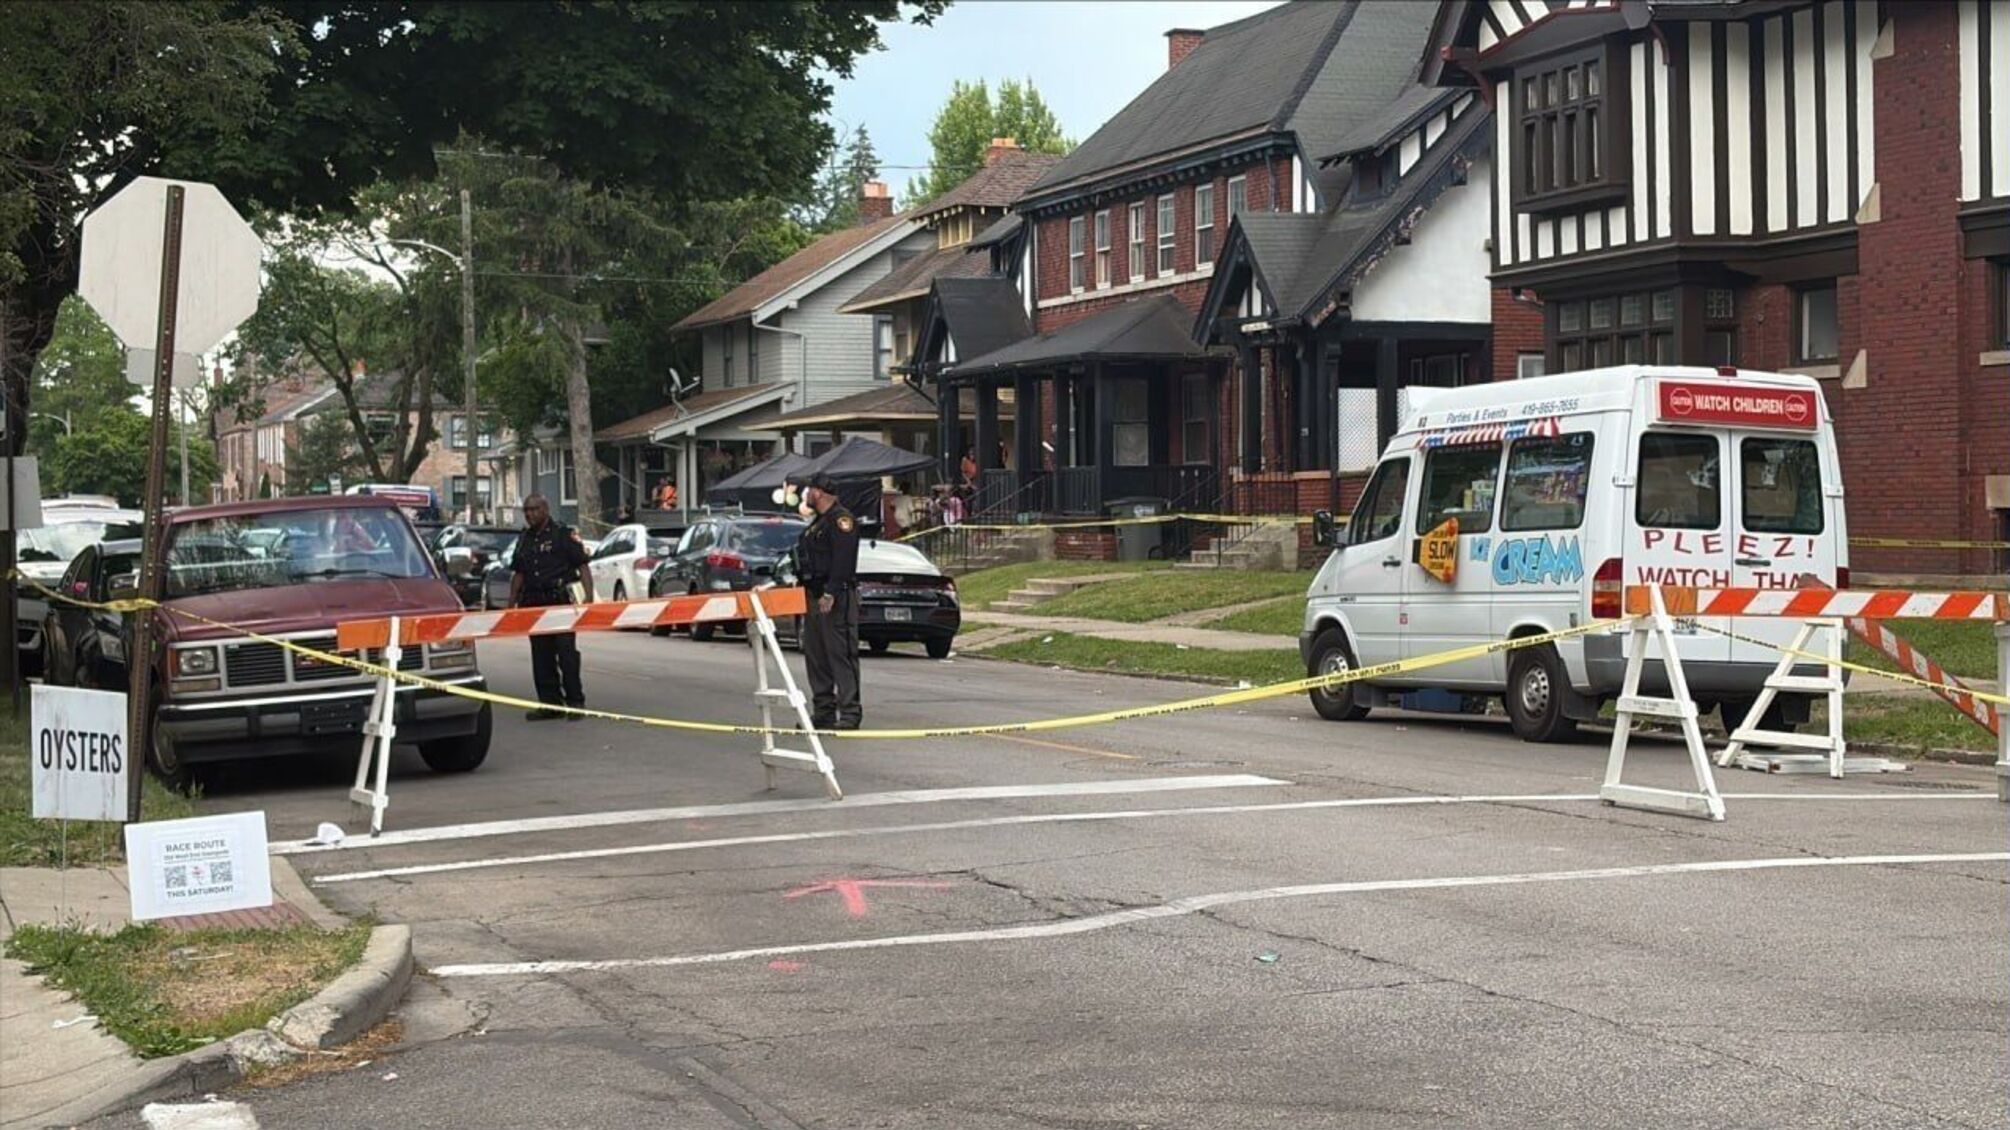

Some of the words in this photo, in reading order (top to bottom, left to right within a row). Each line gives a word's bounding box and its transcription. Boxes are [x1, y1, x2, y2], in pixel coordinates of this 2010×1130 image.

[1694, 394, 1731, 411] WATCH
[1733, 396, 1784, 415] CHILDREN
[1446, 412, 1471, 424] Parties
[1482, 408, 1508, 420] Events
[1429, 540, 1456, 560] SLOW
[1643, 529, 1814, 558] PLEEZ!
[1470, 537, 1491, 561] ICE
[1492, 534, 1584, 585] CREAM
[1637, 566, 1730, 588] WATCH
[41, 728, 122, 774] OYSTERS
[165, 842, 191, 852] RACE
[193, 839, 226, 849] ROUTE
[166, 890, 186, 899] THIS
[188, 885, 234, 897] SATURDAY!
